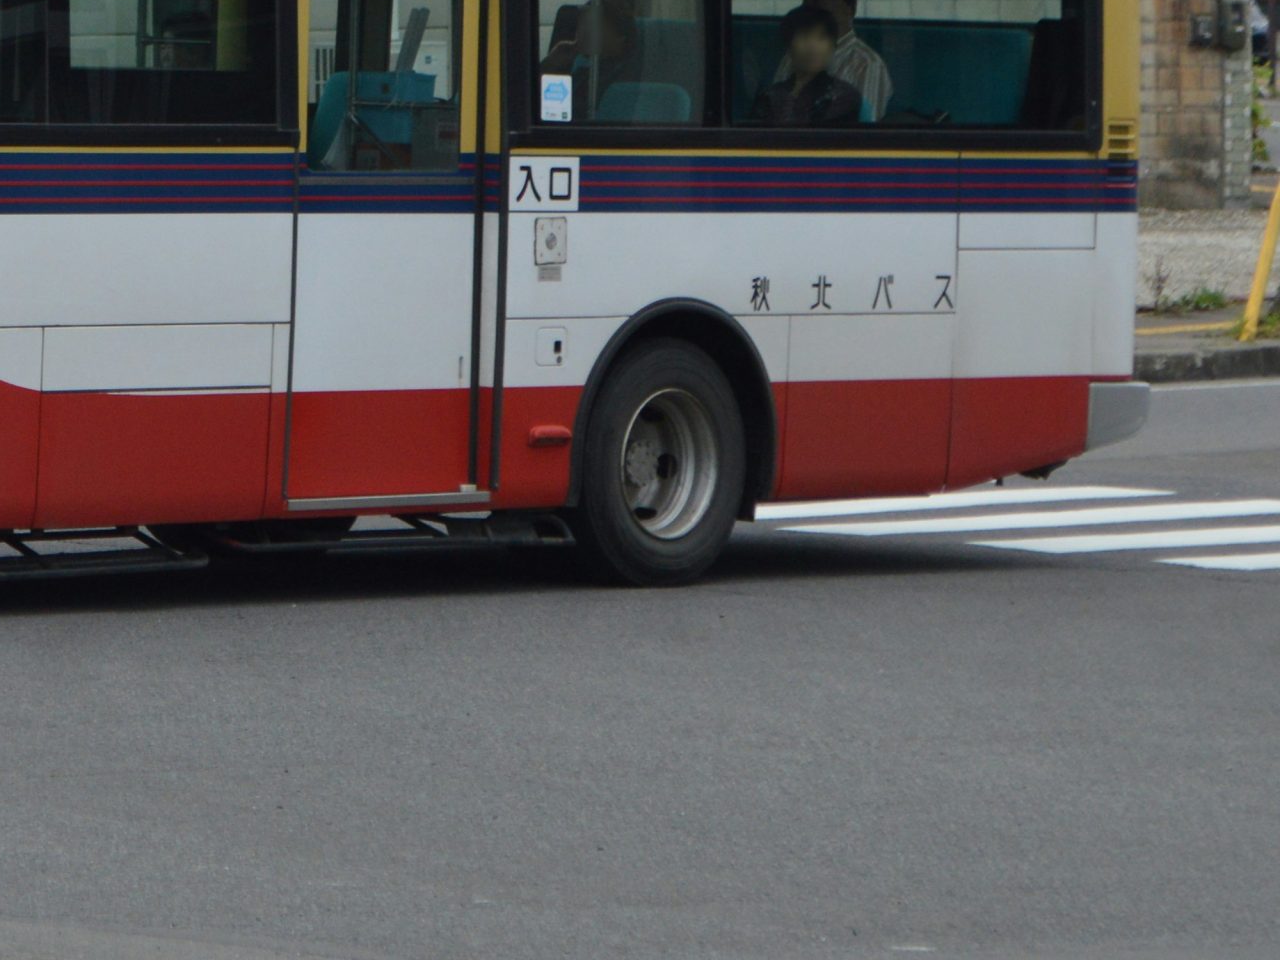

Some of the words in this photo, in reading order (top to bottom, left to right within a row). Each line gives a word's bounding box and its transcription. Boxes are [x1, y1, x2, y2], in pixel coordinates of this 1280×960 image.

[517, 166, 572, 202] 入口
[750, 275, 954, 311] 秋北バス
